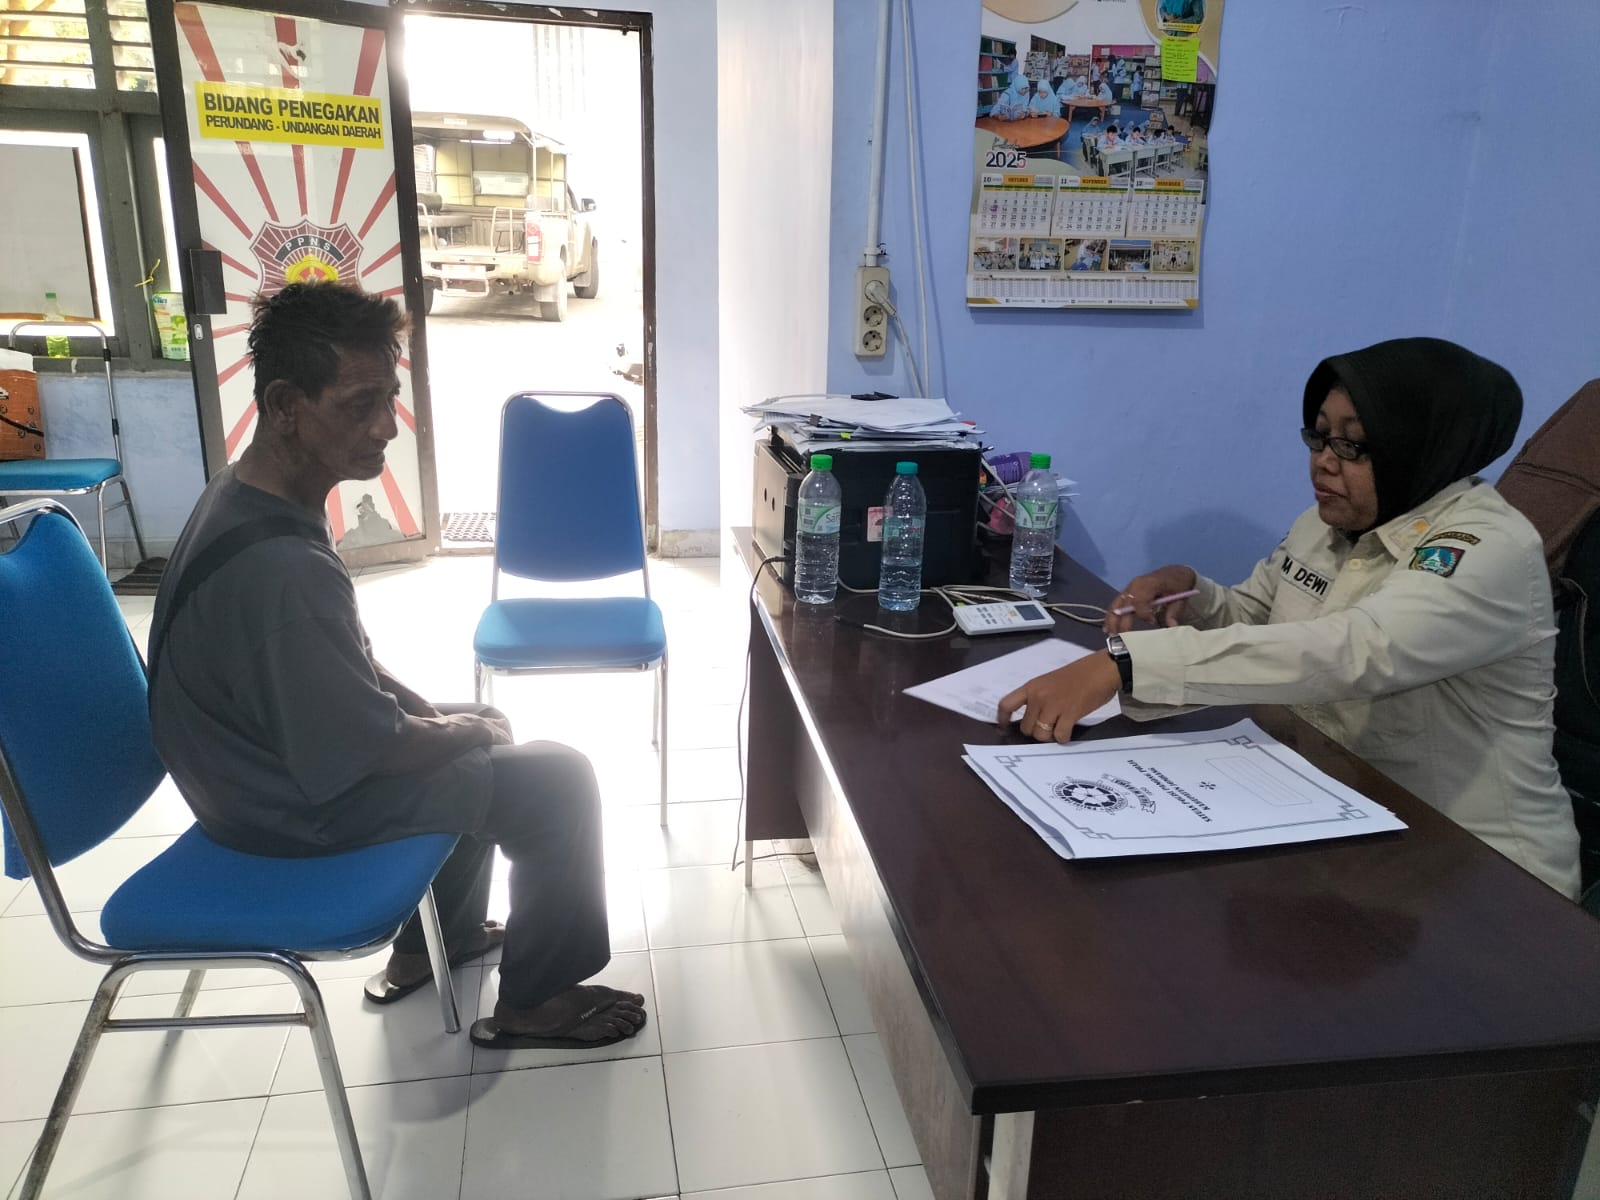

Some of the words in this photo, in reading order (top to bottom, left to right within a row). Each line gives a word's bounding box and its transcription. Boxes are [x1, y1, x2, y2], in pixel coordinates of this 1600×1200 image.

[204, 92, 273, 115] BIDANG
[279, 99, 379, 124] PENEGAKAN
[206, 115, 273, 131] PERUNDANG
[282, 121, 340, 136] UNDANGAN
[342, 125, 381, 139] DAERAH
[986, 151, 1027, 168] 2025
[285, 237, 331, 251] PPNS
[1293, 567, 1328, 596] DEWI
